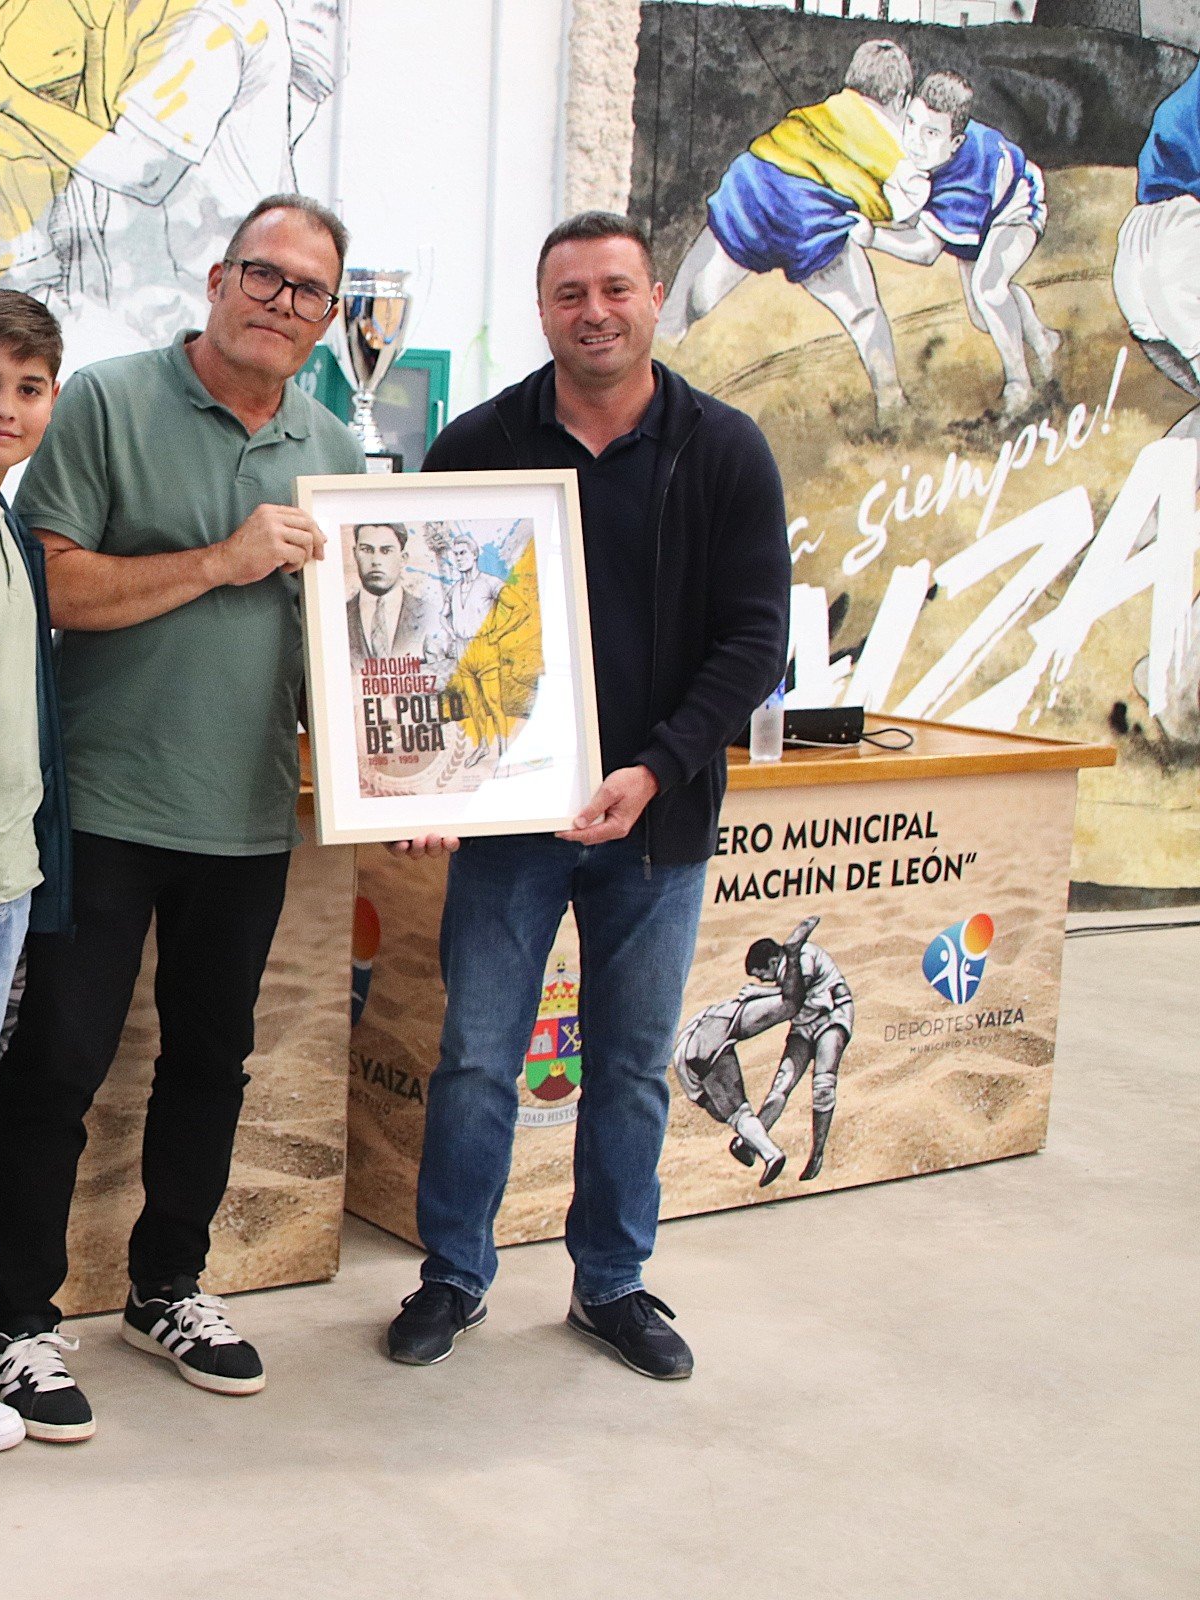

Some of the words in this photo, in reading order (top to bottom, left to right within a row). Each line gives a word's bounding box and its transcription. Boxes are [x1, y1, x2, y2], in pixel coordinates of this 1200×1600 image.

[363, 698, 389, 725] EL
[395, 692, 464, 724] POLLO
[365, 726, 394, 754] DE
[401, 723, 446, 752] UGA
[782, 811, 938, 850] MUNICIPAL
[714, 857, 836, 904] MACHÍN
[846, 861, 882, 891] DE
